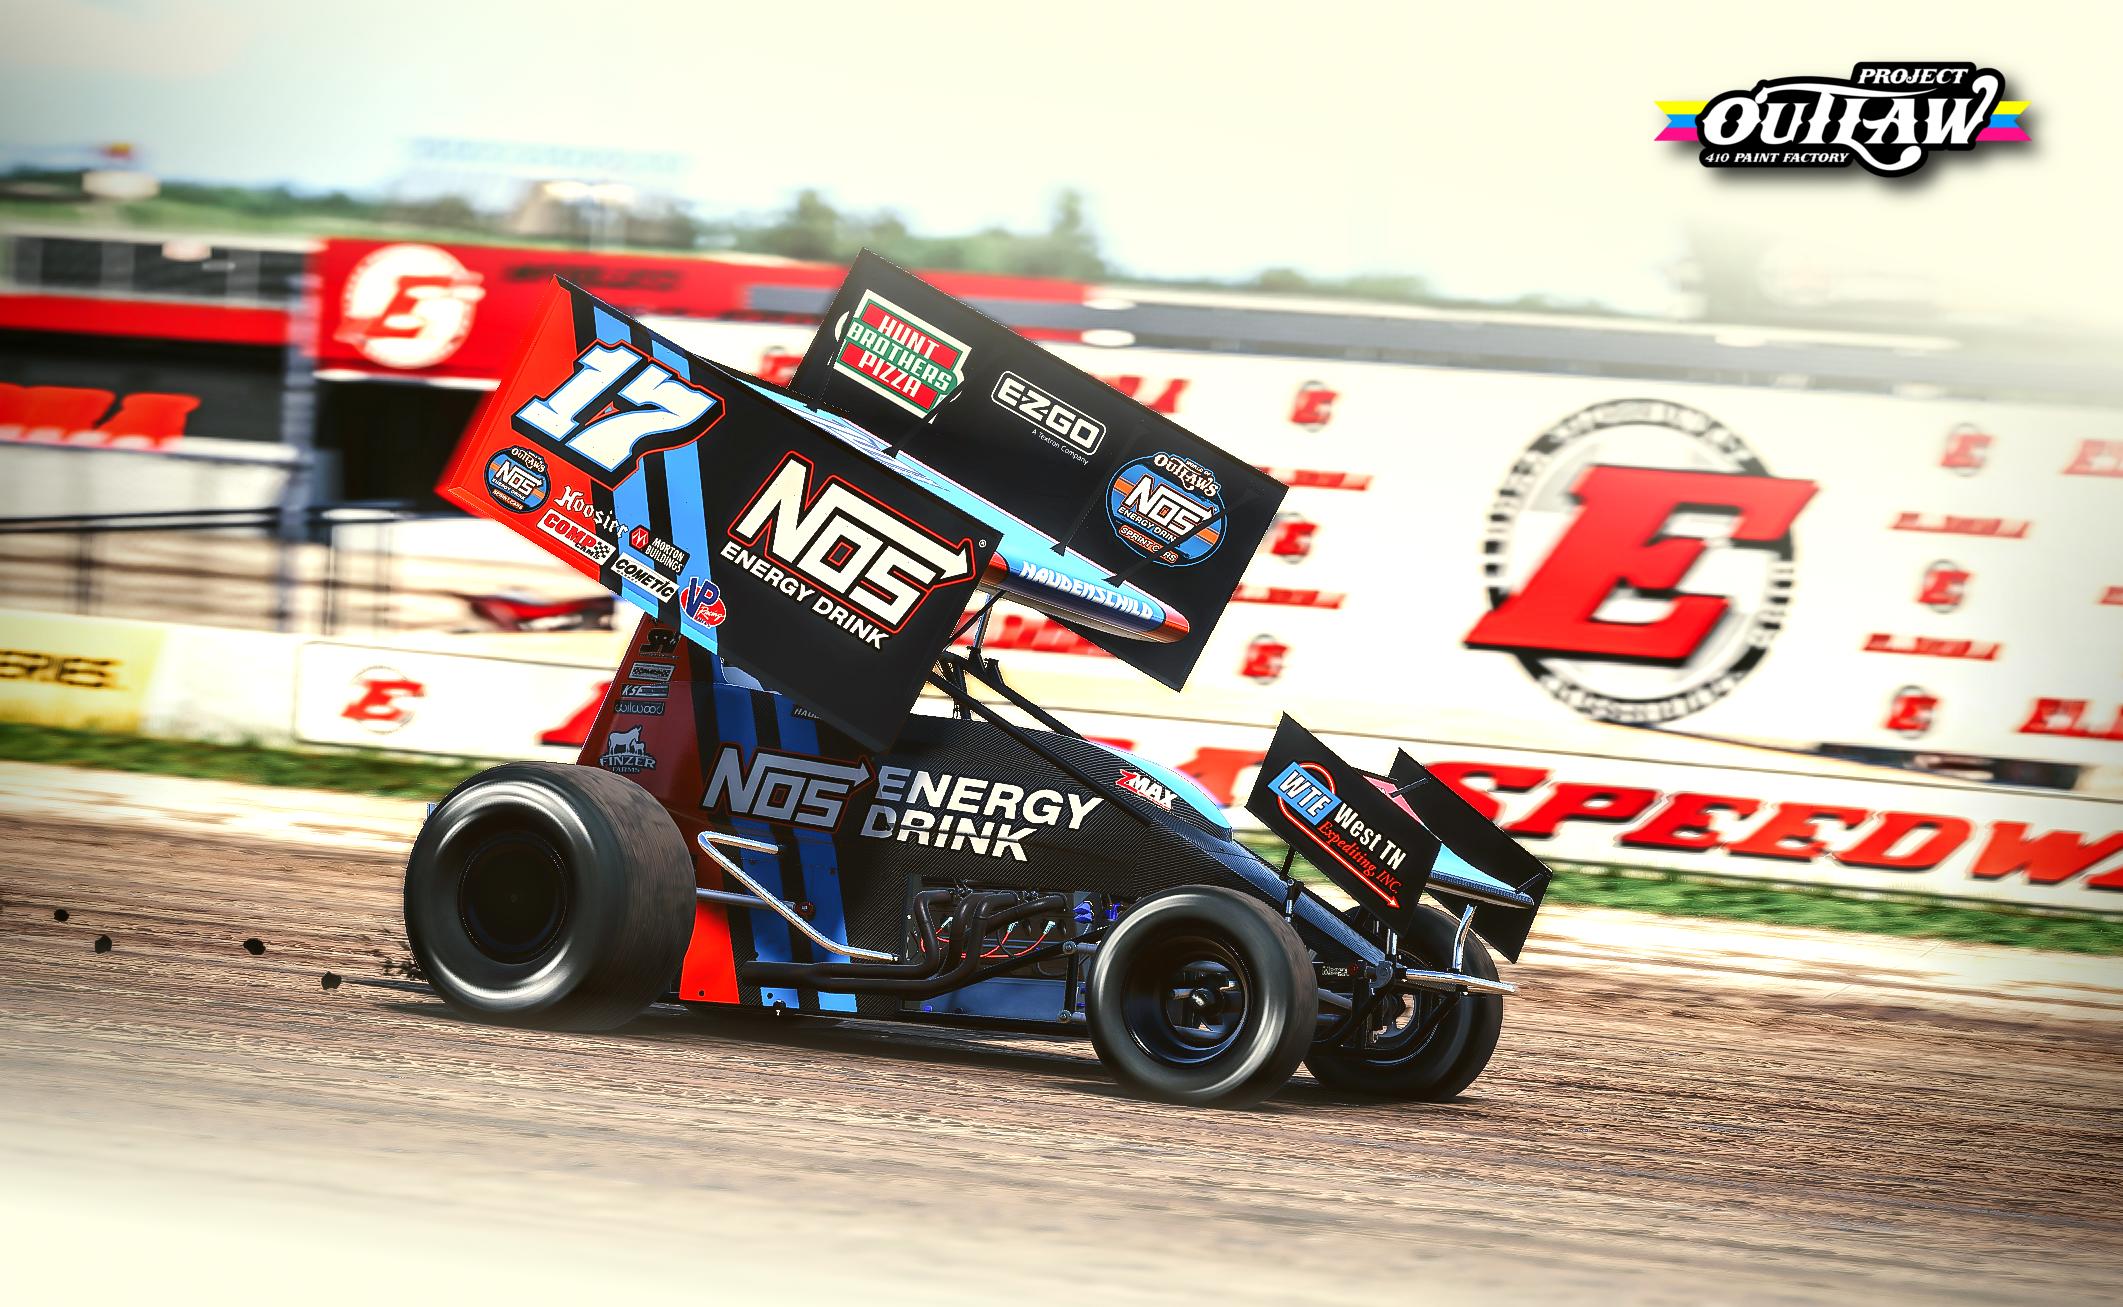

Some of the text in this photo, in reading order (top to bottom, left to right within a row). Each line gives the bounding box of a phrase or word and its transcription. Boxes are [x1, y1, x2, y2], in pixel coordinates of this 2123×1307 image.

[847, 321, 952, 391] BROTHERS
[878, 315, 939, 359] HUNT
[858, 350, 922, 398] PIZZA
[515, 344, 718, 473] 17
[997, 377, 1100, 449] EZGO
[1038, 430, 1060, 448] Textron
[1060, 445, 1089, 465] Company
[495, 460, 543, 496] NOS
[554, 485, 629, 538] Hoosier
[1117, 506, 1178, 543] ENERGY DRIN
[1125, 476, 1214, 536] NOS
[543, 511, 598, 550] COMP
[651, 537, 685, 562] MORTON
[736, 459, 968, 626] NOS
[1120, 526, 1178, 562] SPRINT CRS
[614, 558, 675, 598] COMETIC
[645, 546, 683, 573] BUILDINGS
[686, 577, 720, 619] VP
[697, 605, 724, 622] Racing
[720, 541, 815, 601] ENERGY
[812, 595, 890, 649] DRINK
[615, 702, 664, 715] wilwood
[600, 756, 656, 768] FINZER
[703, 747, 870, 828] NOS
[875, 765, 1103, 830] ENERGY
[1279, 771, 1332, 817] WTE
[860, 804, 1038, 862] DRINK
[1333, 803, 1407, 870] West TN
[1425, 761, 2123, 894] SPEEDW
[1376, 871, 1402, 894] INC.
